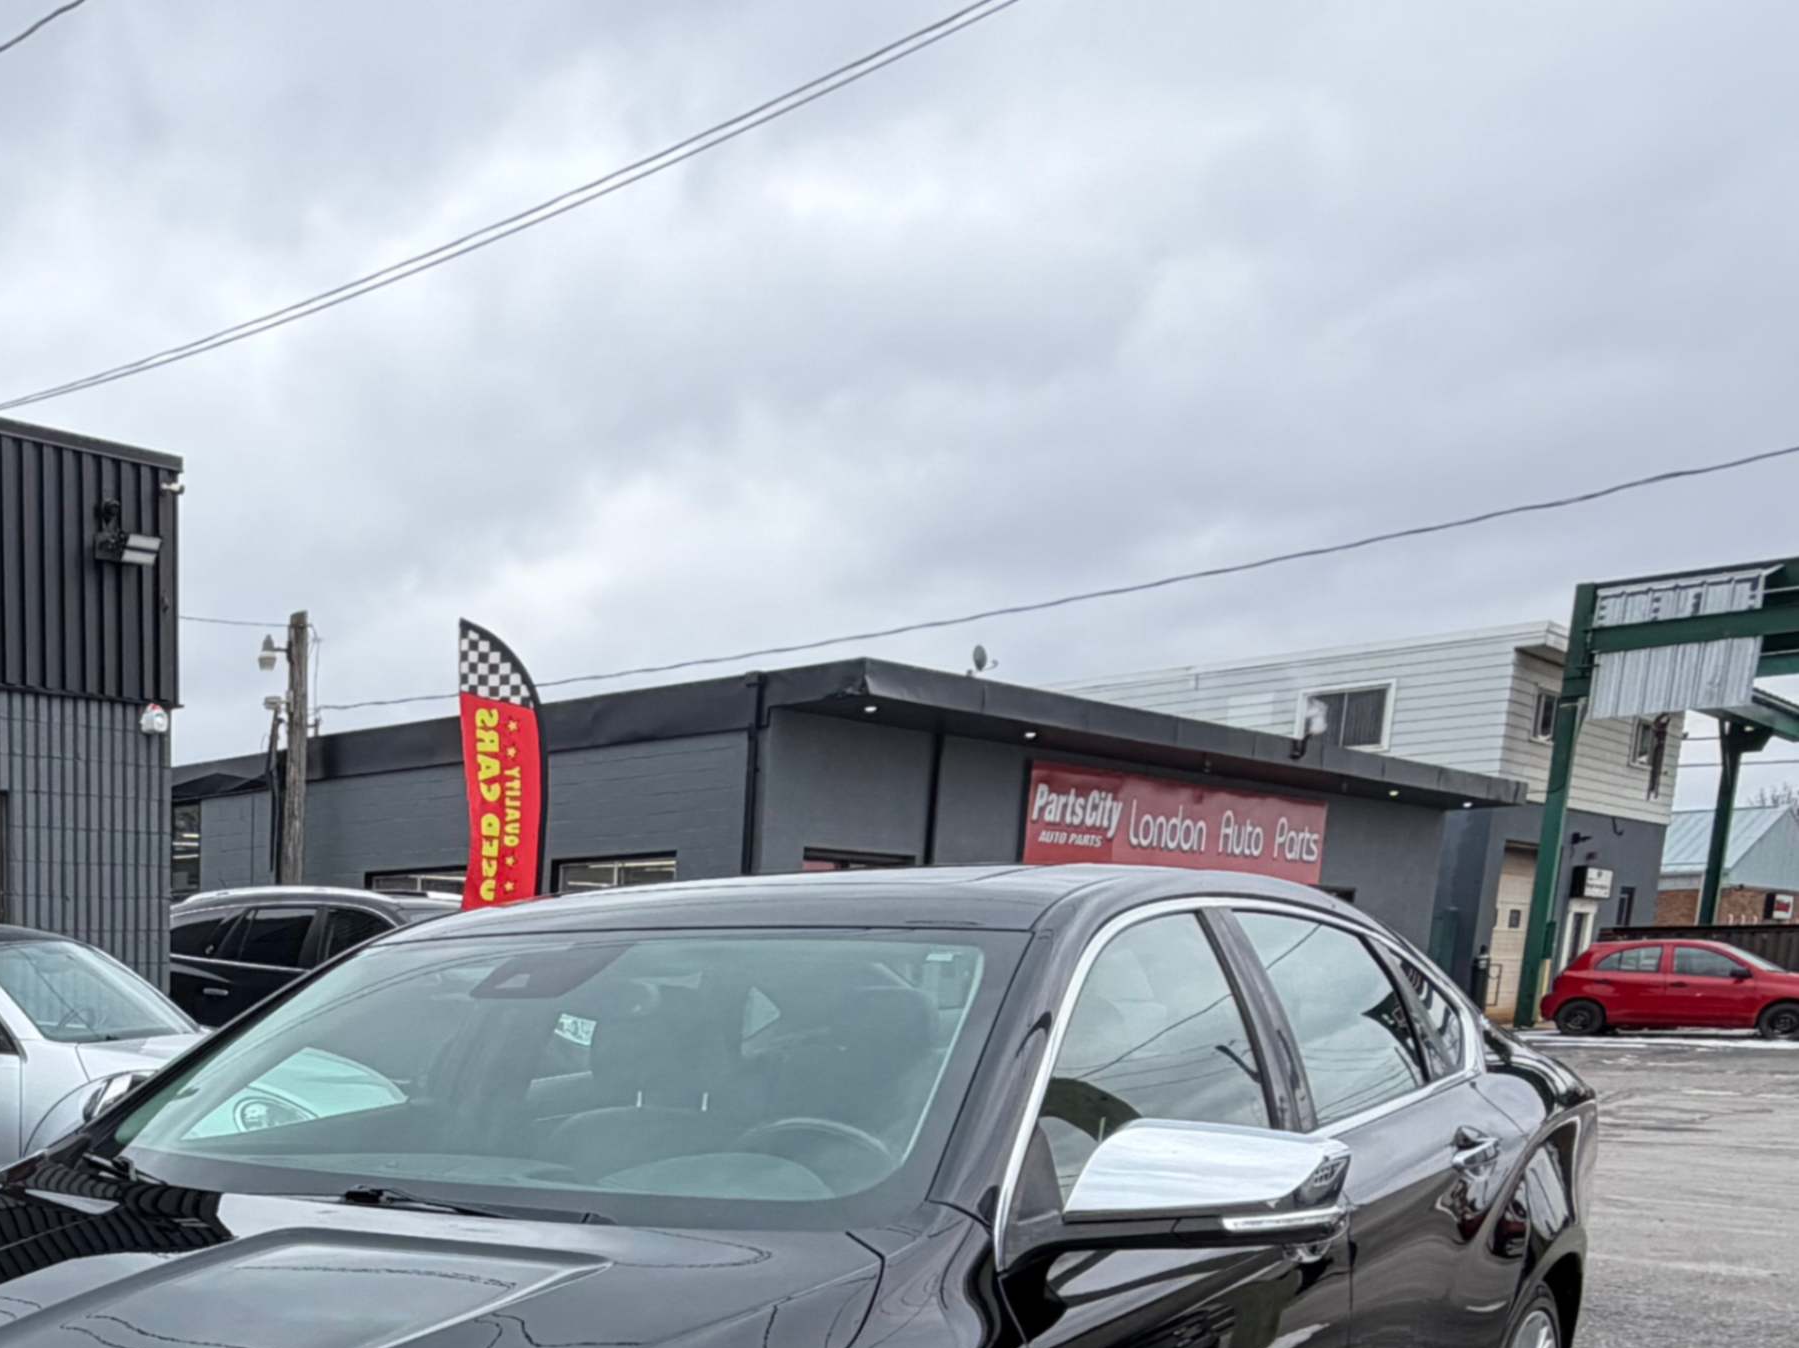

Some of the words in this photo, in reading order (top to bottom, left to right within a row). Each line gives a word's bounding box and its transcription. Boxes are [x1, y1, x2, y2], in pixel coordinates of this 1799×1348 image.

[1038, 830, 1067, 845] AUTO
[1068, 832, 1103, 848] PARTS
[1129, 800, 1206, 851] London
[1219, 810, 1262, 857] Auto
[1273, 817, 1319, 862] Parts
